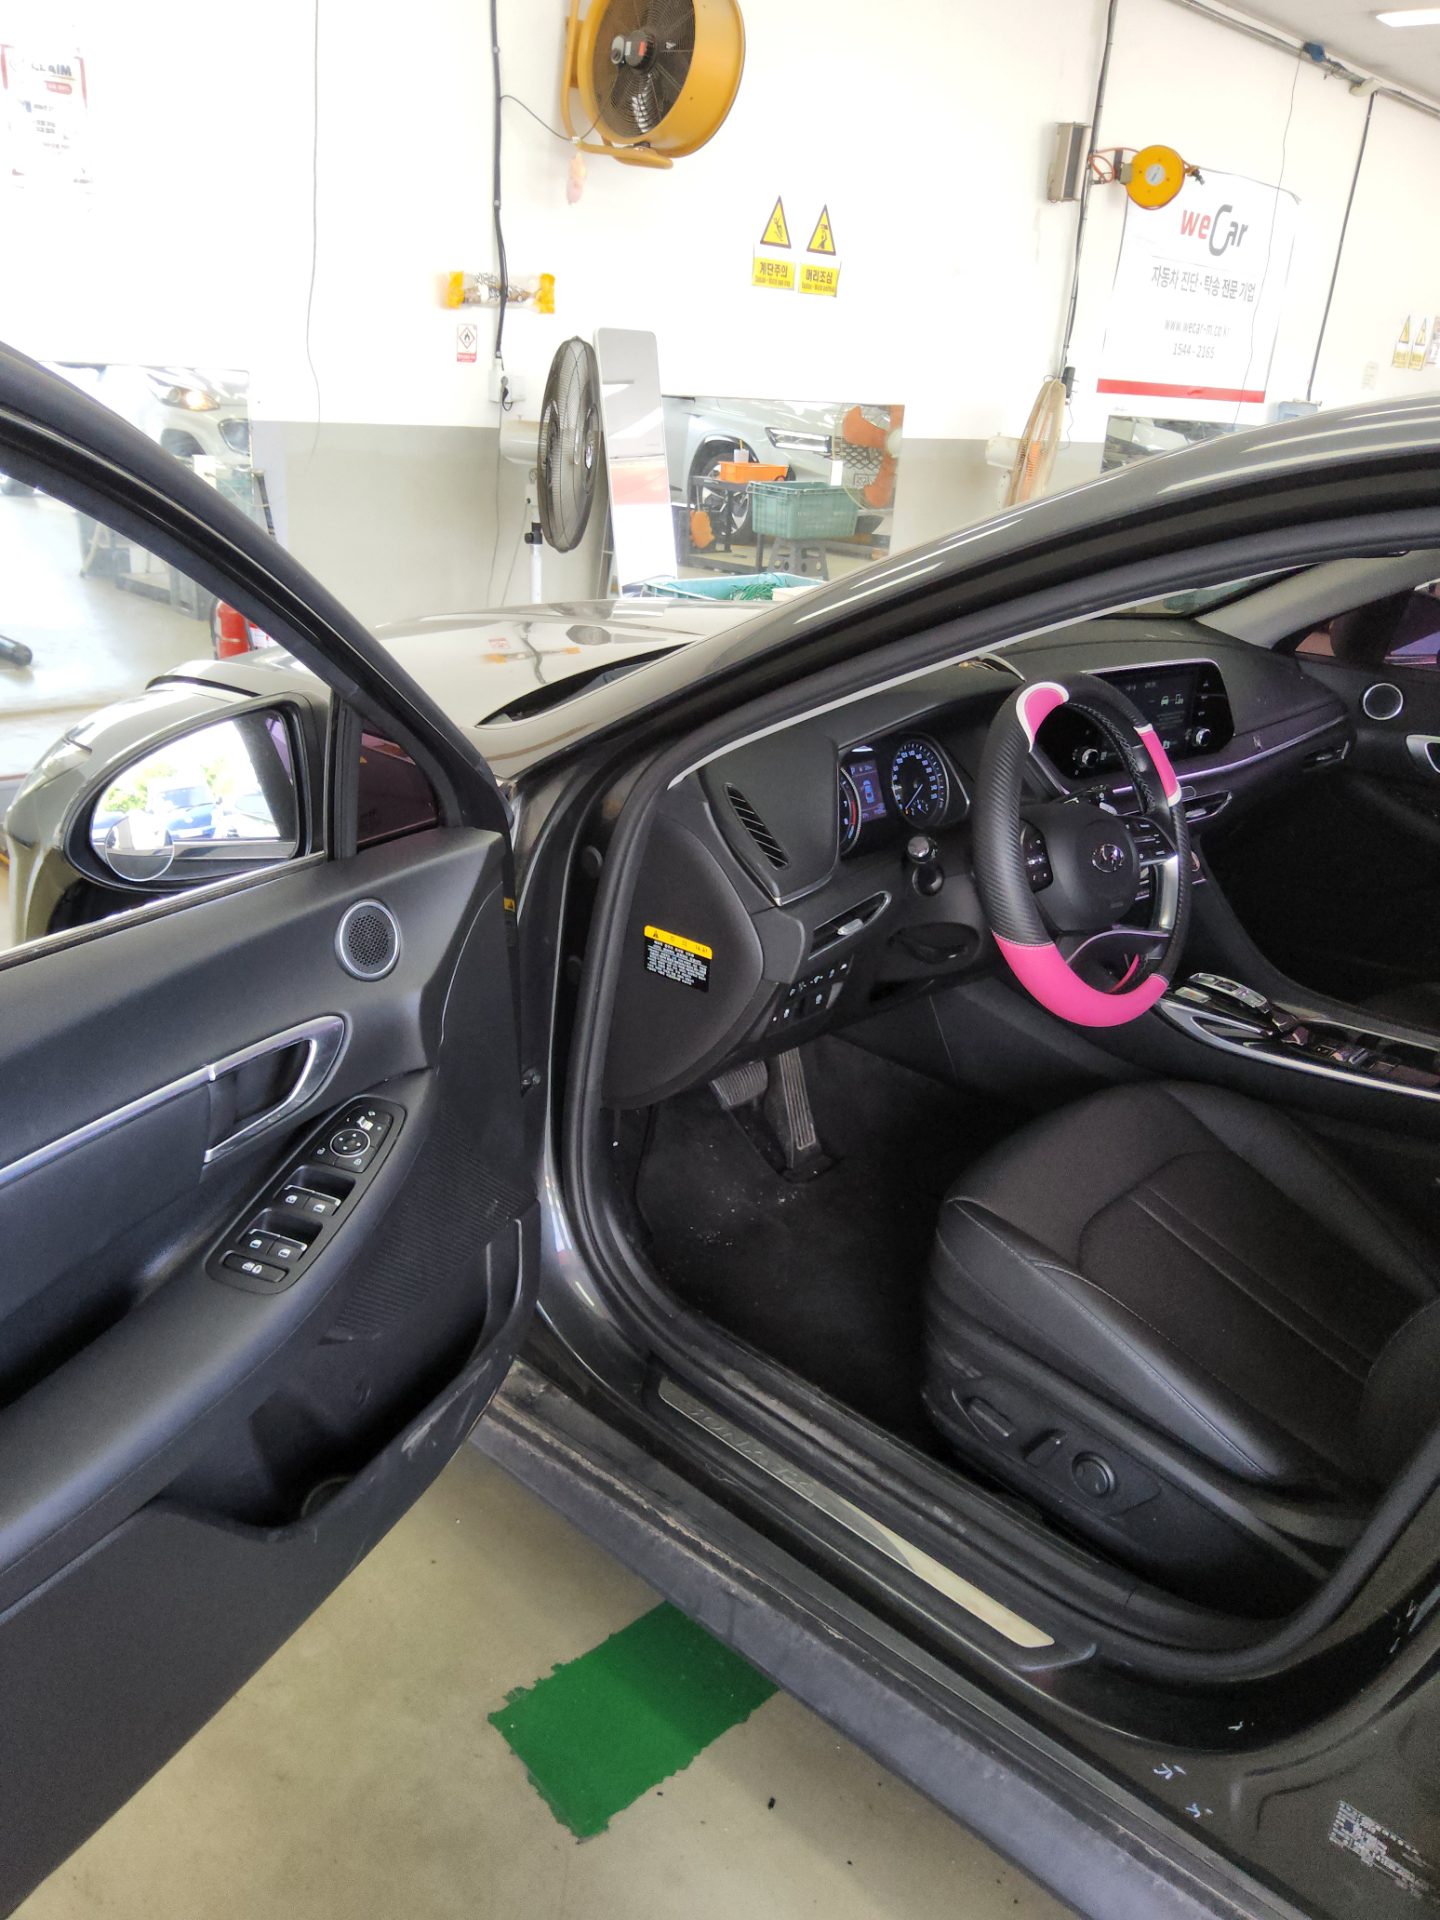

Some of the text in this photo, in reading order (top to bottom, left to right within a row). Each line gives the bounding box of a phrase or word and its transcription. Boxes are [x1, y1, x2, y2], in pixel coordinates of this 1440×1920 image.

[1180, 204, 1249, 256] weCar
[760, 262, 788, 278] 계단주의
[806, 268, 833, 285] 머리조심
[1152, 266, 1179, 289] 자동차
[1222, 279, 1238, 299] 전문
[1239, 282, 1256, 302] 기업
